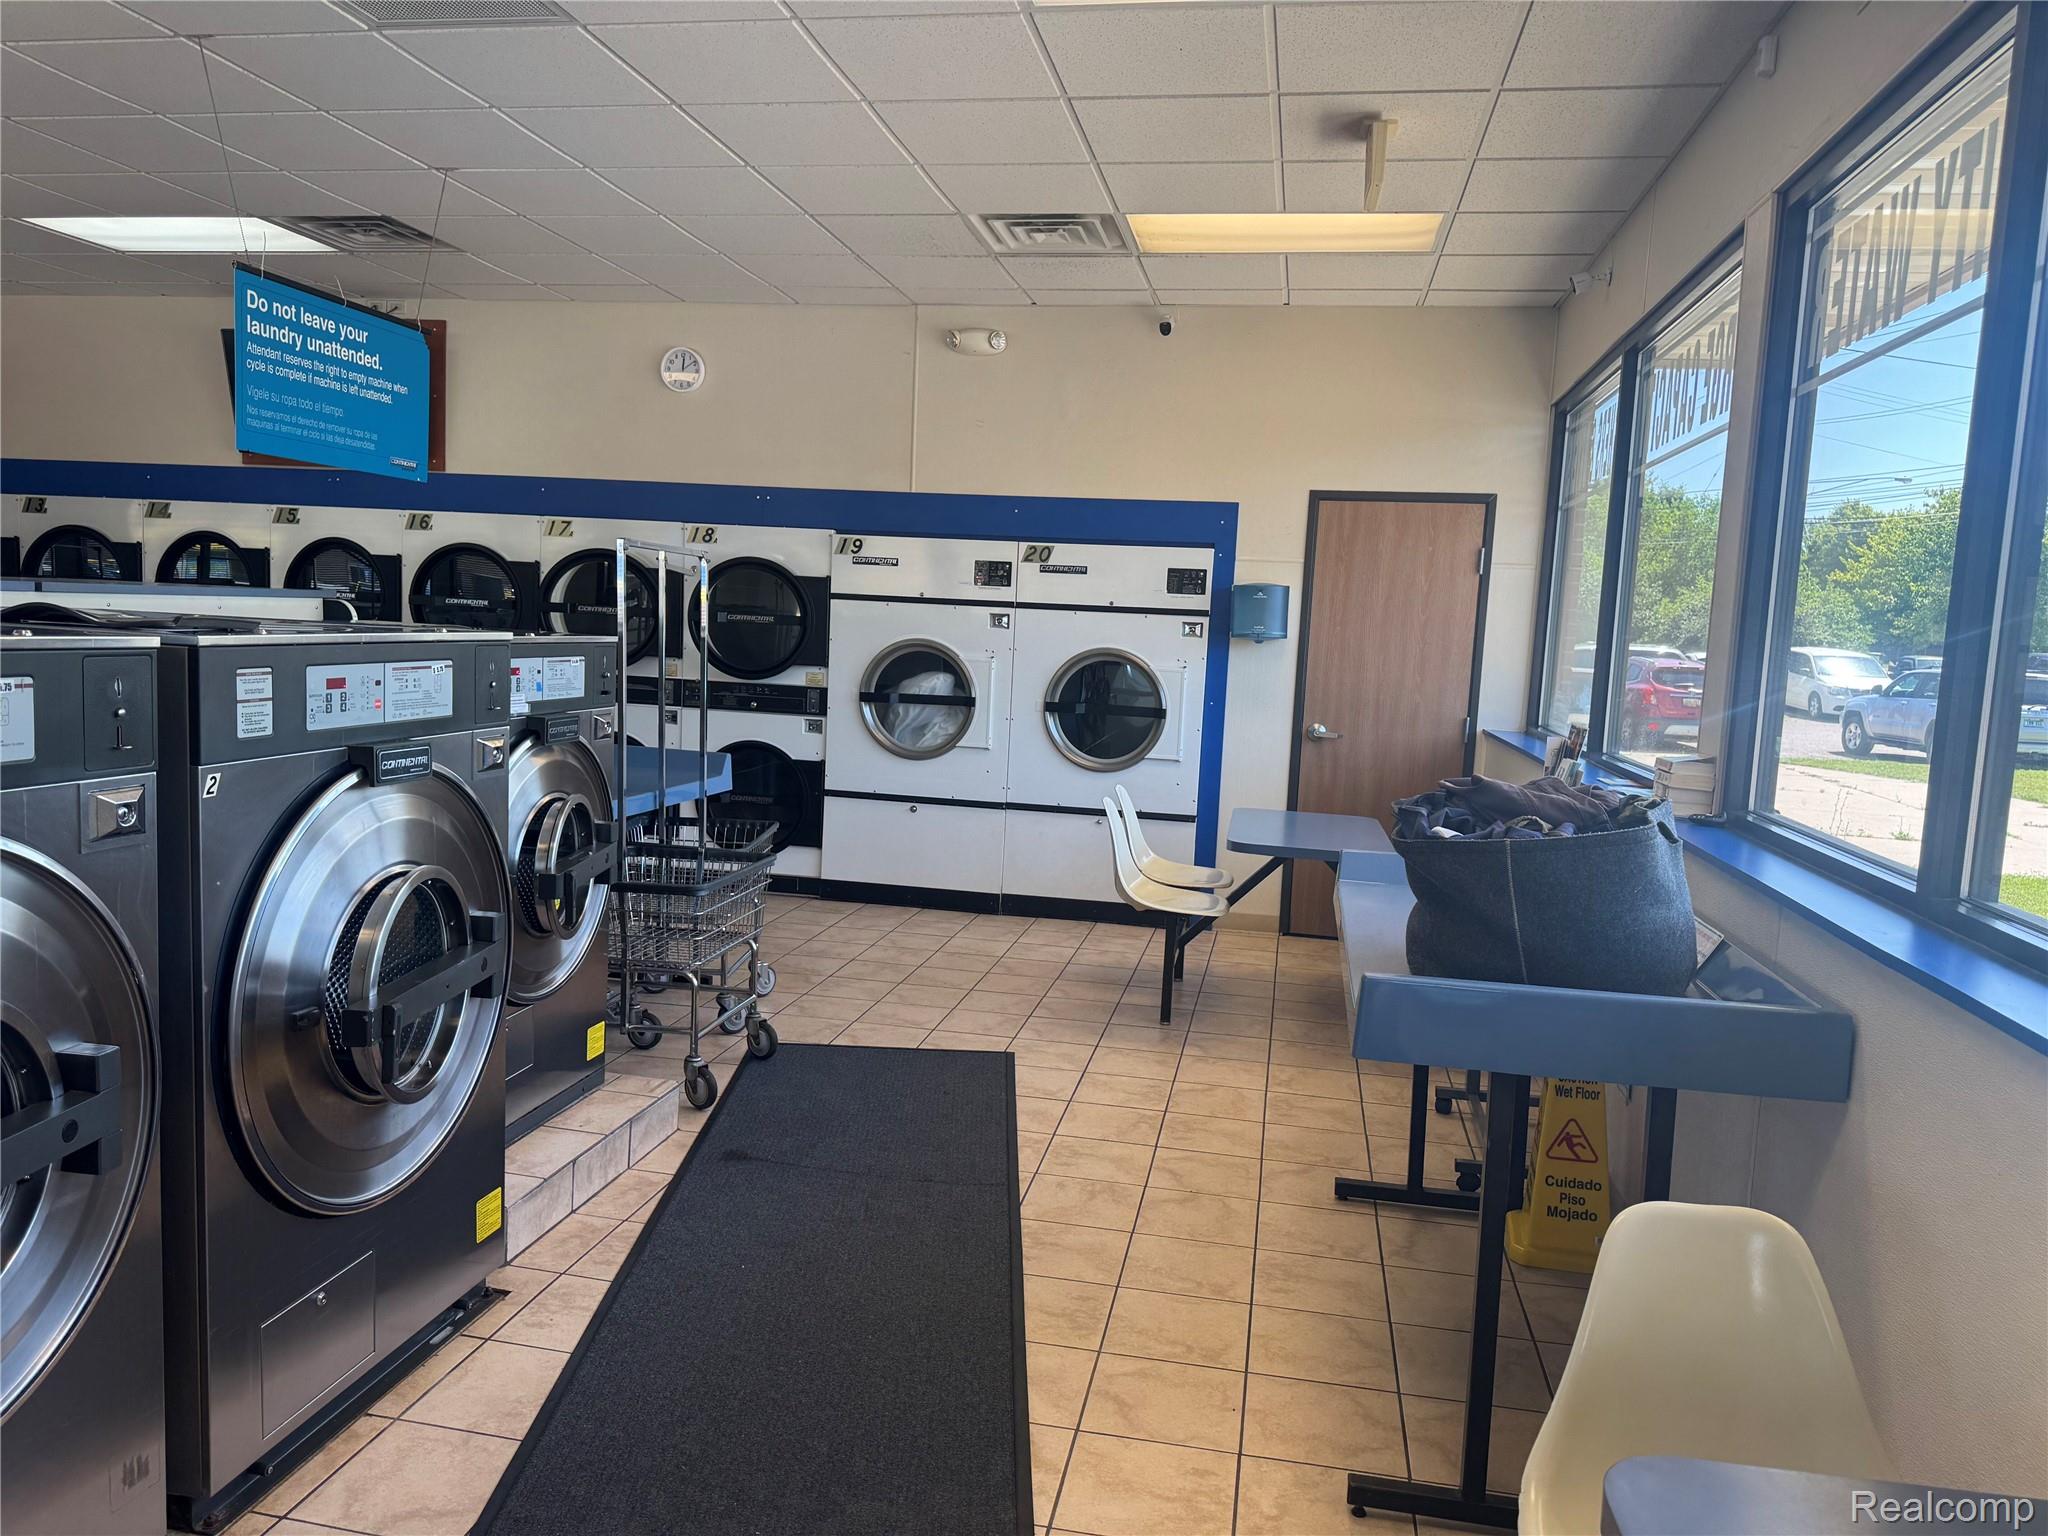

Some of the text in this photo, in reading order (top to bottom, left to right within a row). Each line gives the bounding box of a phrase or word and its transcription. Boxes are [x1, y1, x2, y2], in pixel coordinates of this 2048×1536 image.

[247, 289, 369, 344] Do not leave your
[247, 314, 383, 371] laundry unattended.
[246, 340, 409, 395] Attendant reserves the right to empty machine when
[246, 358, 393, 404] cycle is complete if machine is left unattended.
[271, 392, 280, 403] su
[281, 394, 298, 407] ropa
[298, 397, 314, 410] todo
[314, 401, 321, 412] el
[246, 403, 258, 415] Nos
[258, 408, 291, 423] reservamos
[291, 415, 297, 423] el
[297, 416, 318, 428] derecho
[318, 420, 326, 430] de
[346, 427, 353, 435] su
[839, 538, 863, 555] 19
[1023, 545, 1051, 563] 20
[381, 755, 428, 770] CONTINENTAL
[206, 775, 217, 795] 2
[1554, 1084, 1600, 1101] Wet Floor
[1544, 1175, 1602, 1192] Cuidado
[1559, 1192, 1586, 1206] Piso
[1546, 1205, 1598, 1222] Mojado
